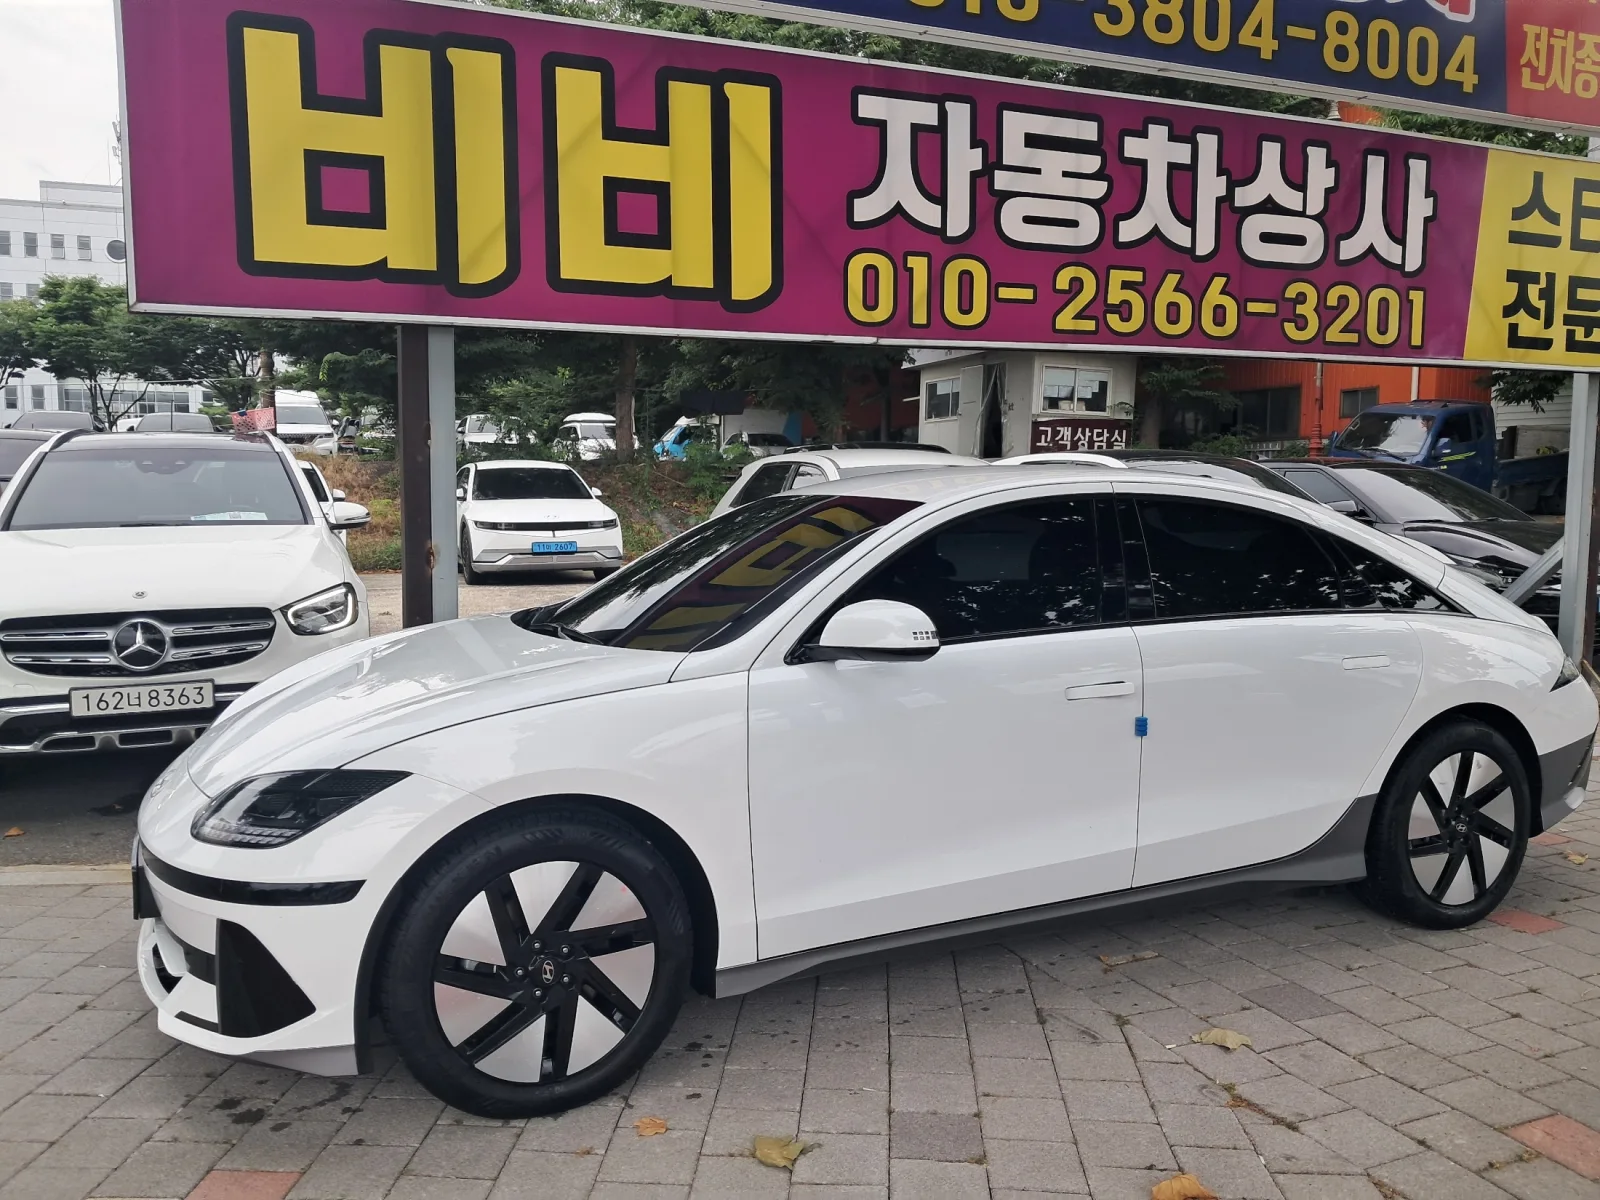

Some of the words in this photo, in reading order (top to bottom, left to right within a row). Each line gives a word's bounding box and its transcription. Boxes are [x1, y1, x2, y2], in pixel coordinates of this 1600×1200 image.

[905, 0, 1479, 93] 3804-8004
[226, 10, 784, 313] 비비
[851, 91, 1436, 275] 자동차상사
[843, 249, 1427, 349] 010-2566-3201
